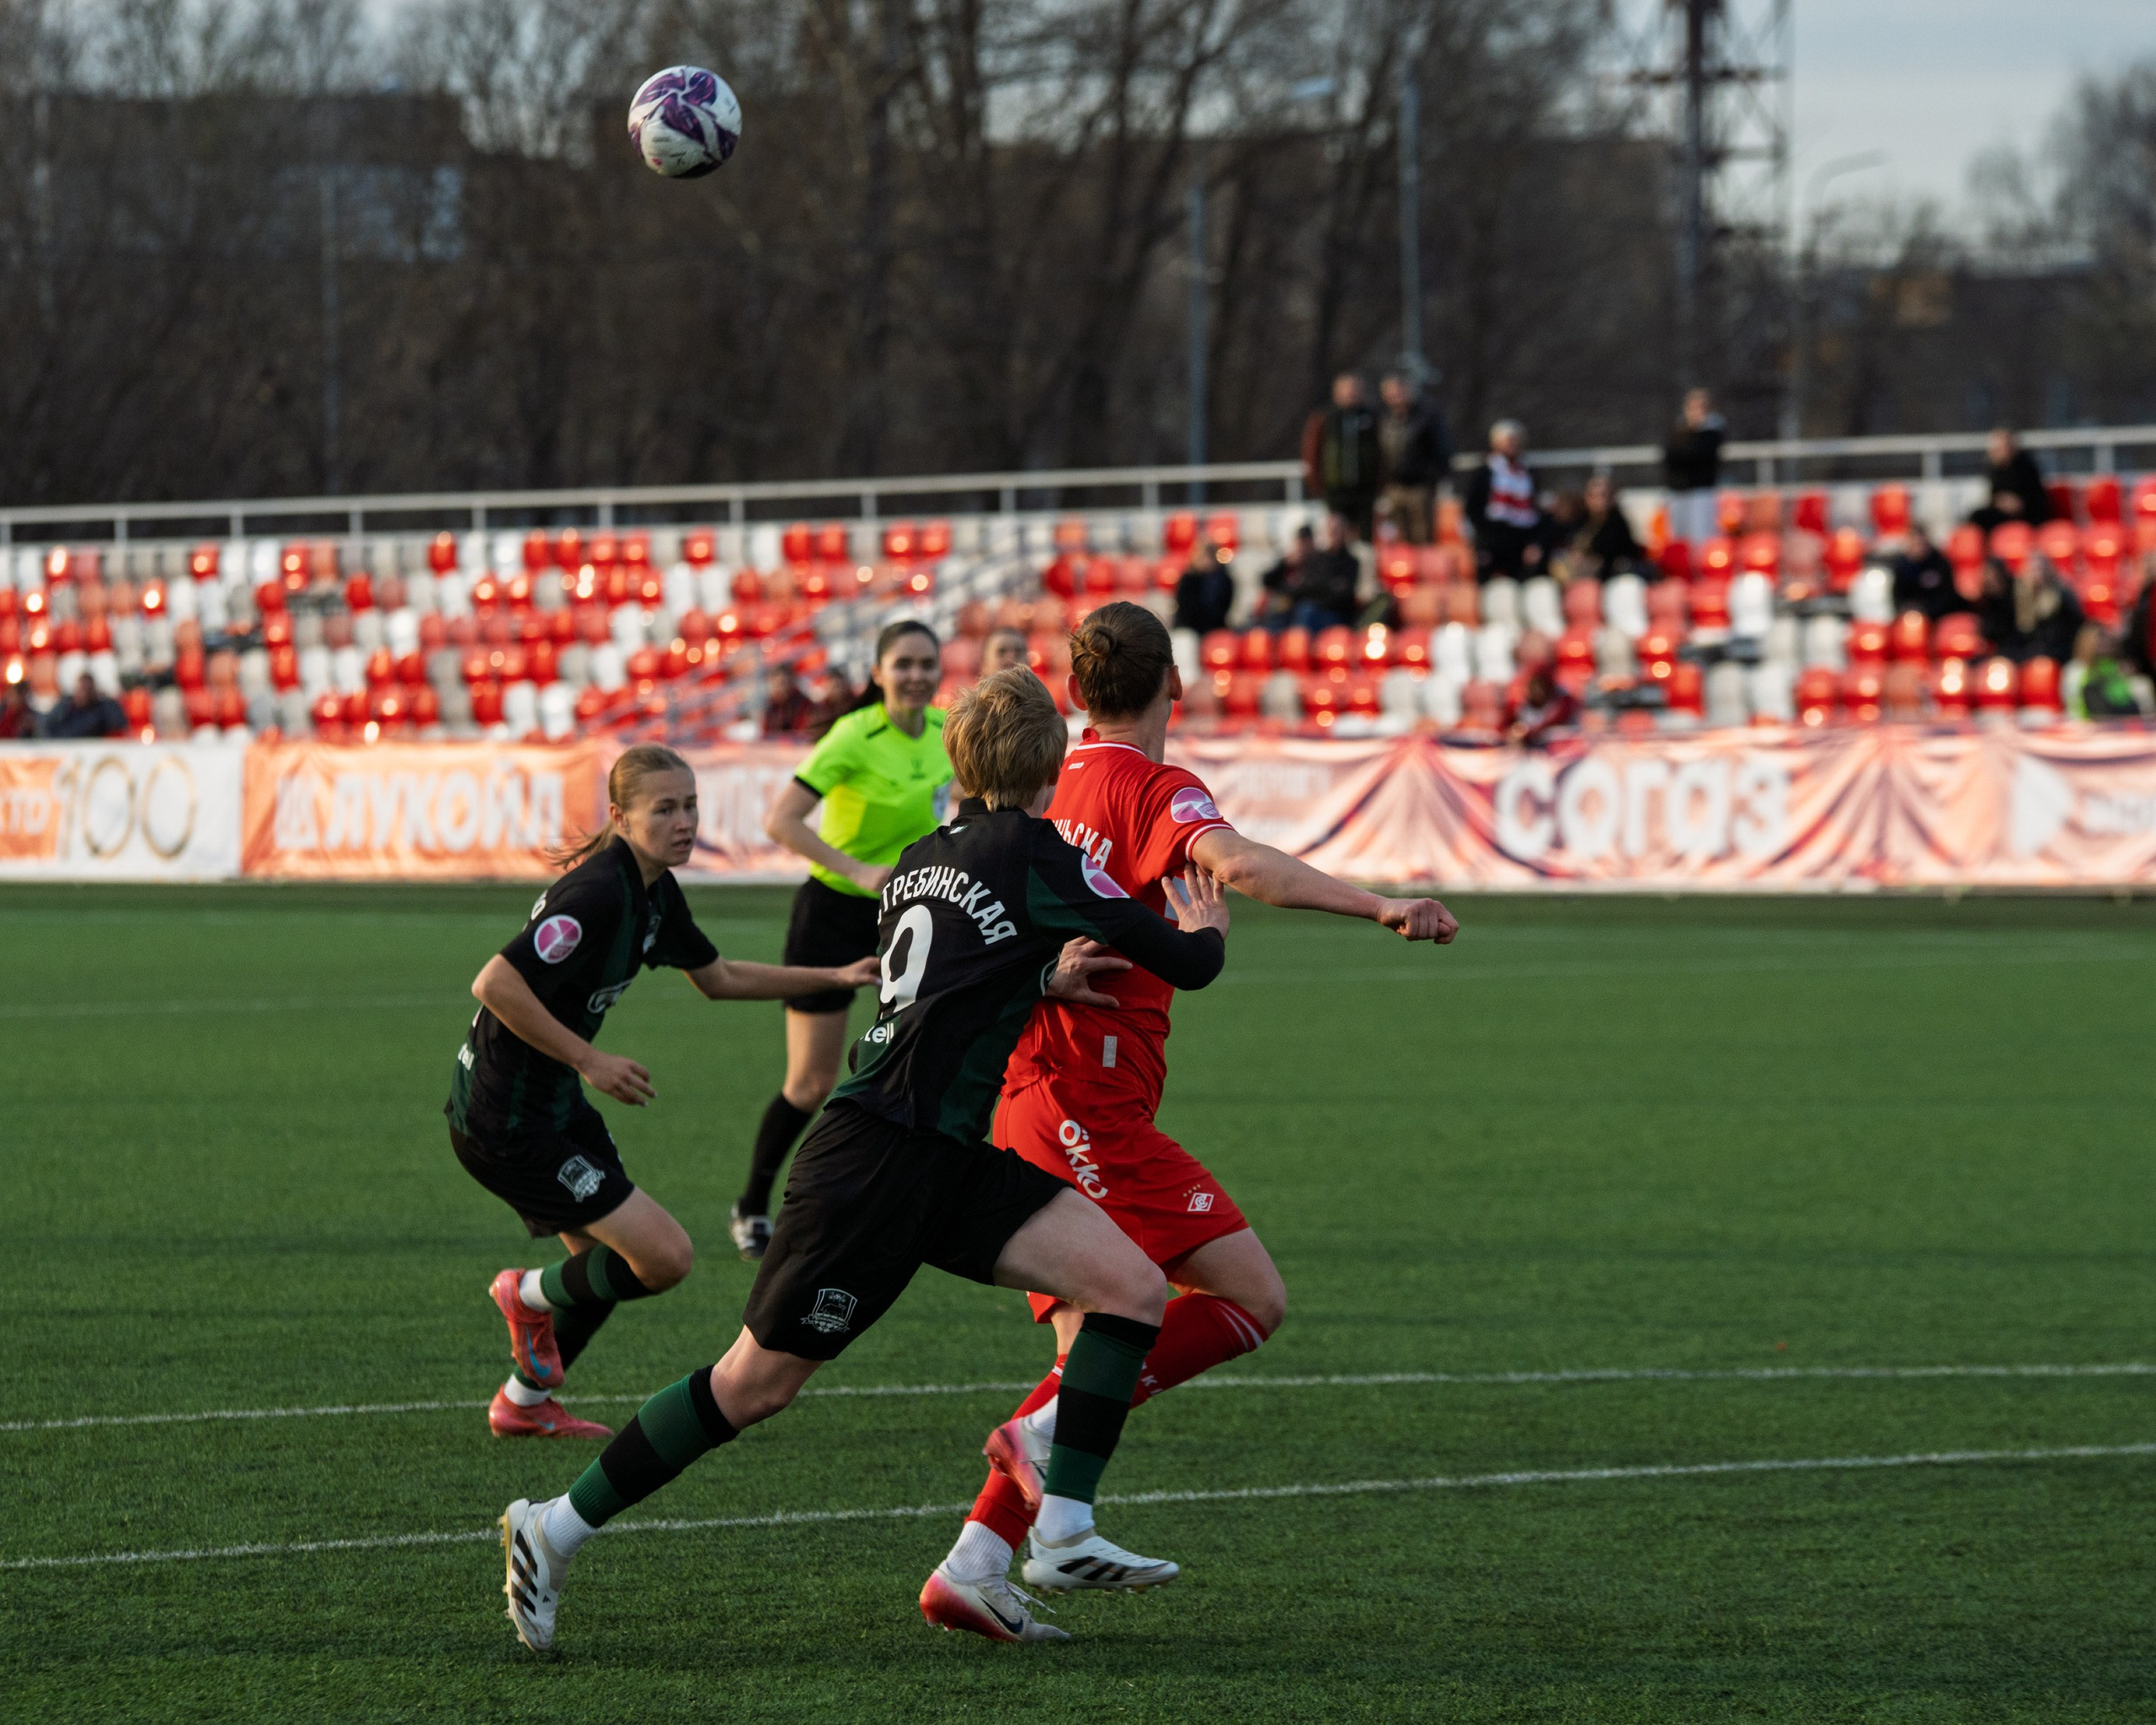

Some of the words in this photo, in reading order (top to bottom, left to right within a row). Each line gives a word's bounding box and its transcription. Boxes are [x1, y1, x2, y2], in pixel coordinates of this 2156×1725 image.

[57, 752, 200, 862] 100
[326, 760, 563, 853] ЛУКОЙЛ
[880, 904, 933, 1013] 9
